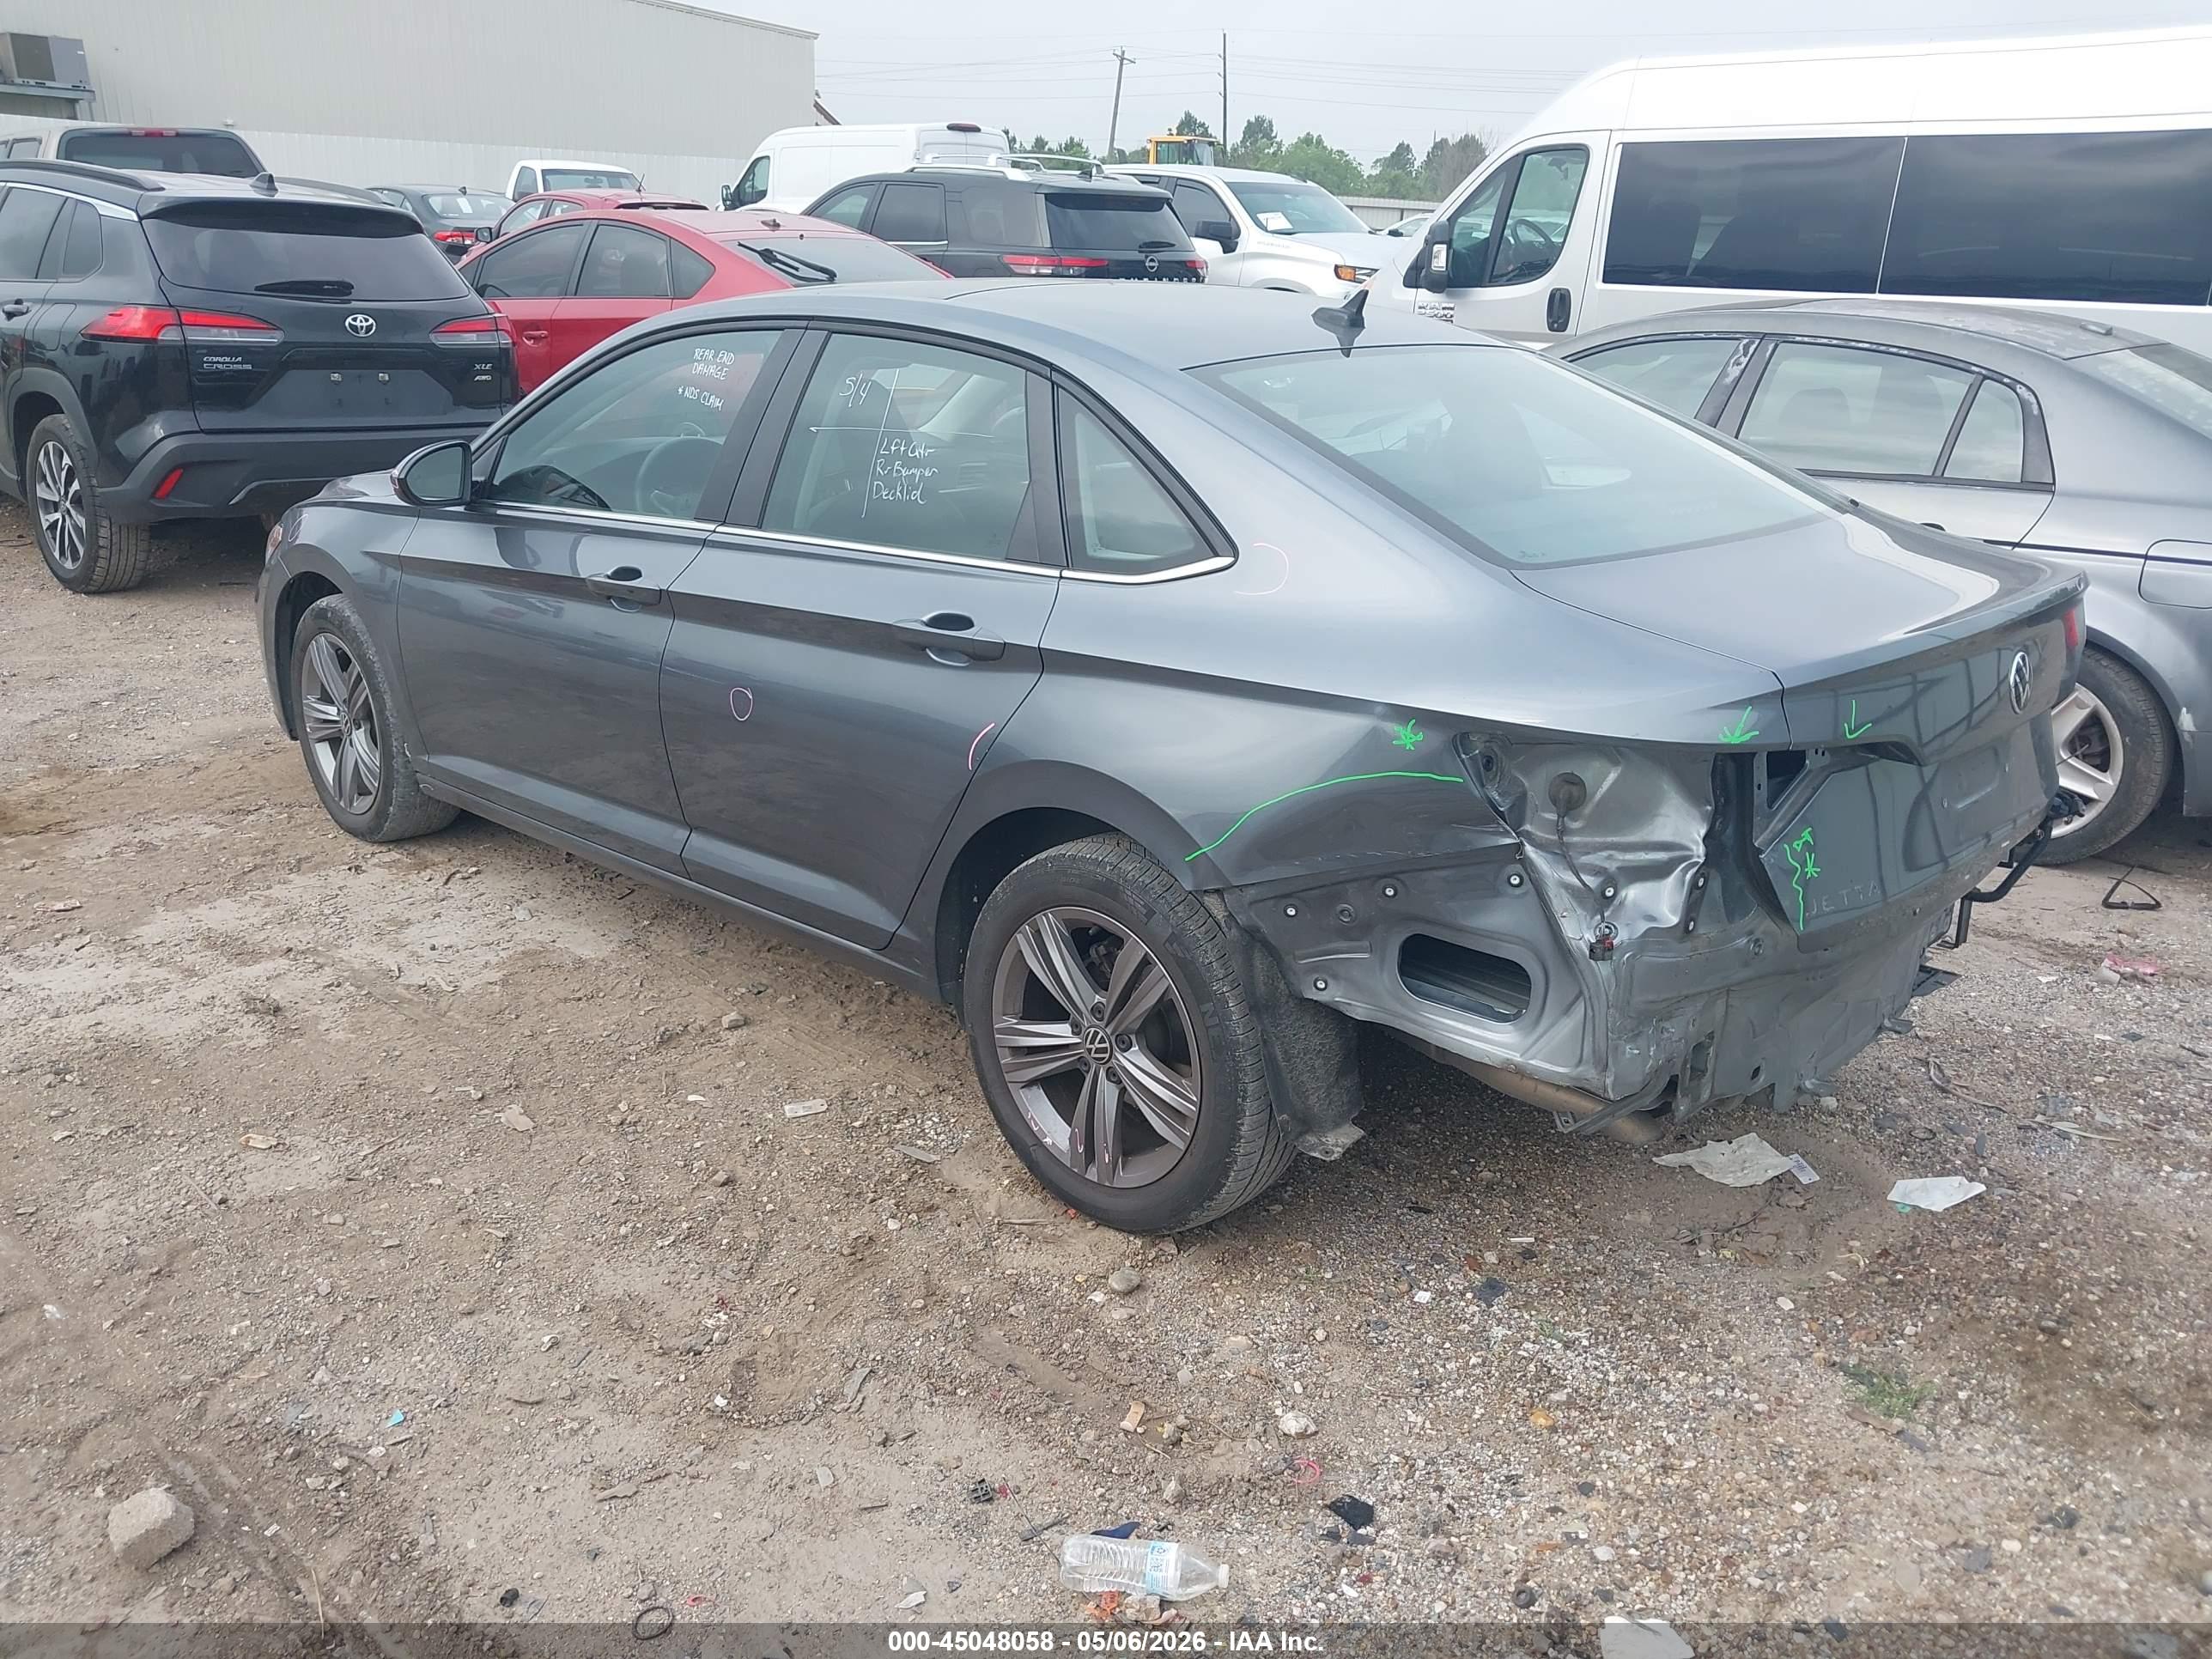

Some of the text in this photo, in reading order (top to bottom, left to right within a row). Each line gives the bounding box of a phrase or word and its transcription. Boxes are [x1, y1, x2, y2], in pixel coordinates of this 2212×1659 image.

[694, 348, 735, 365] REAR END
[692, 362, 729, 380] DAMAGE
[700, 391, 724, 411] CLAIM
[892, 460, 939, 483] Bumper
[872, 480, 927, 505] Decklid
[1812, 879, 1881, 915] JETTA
